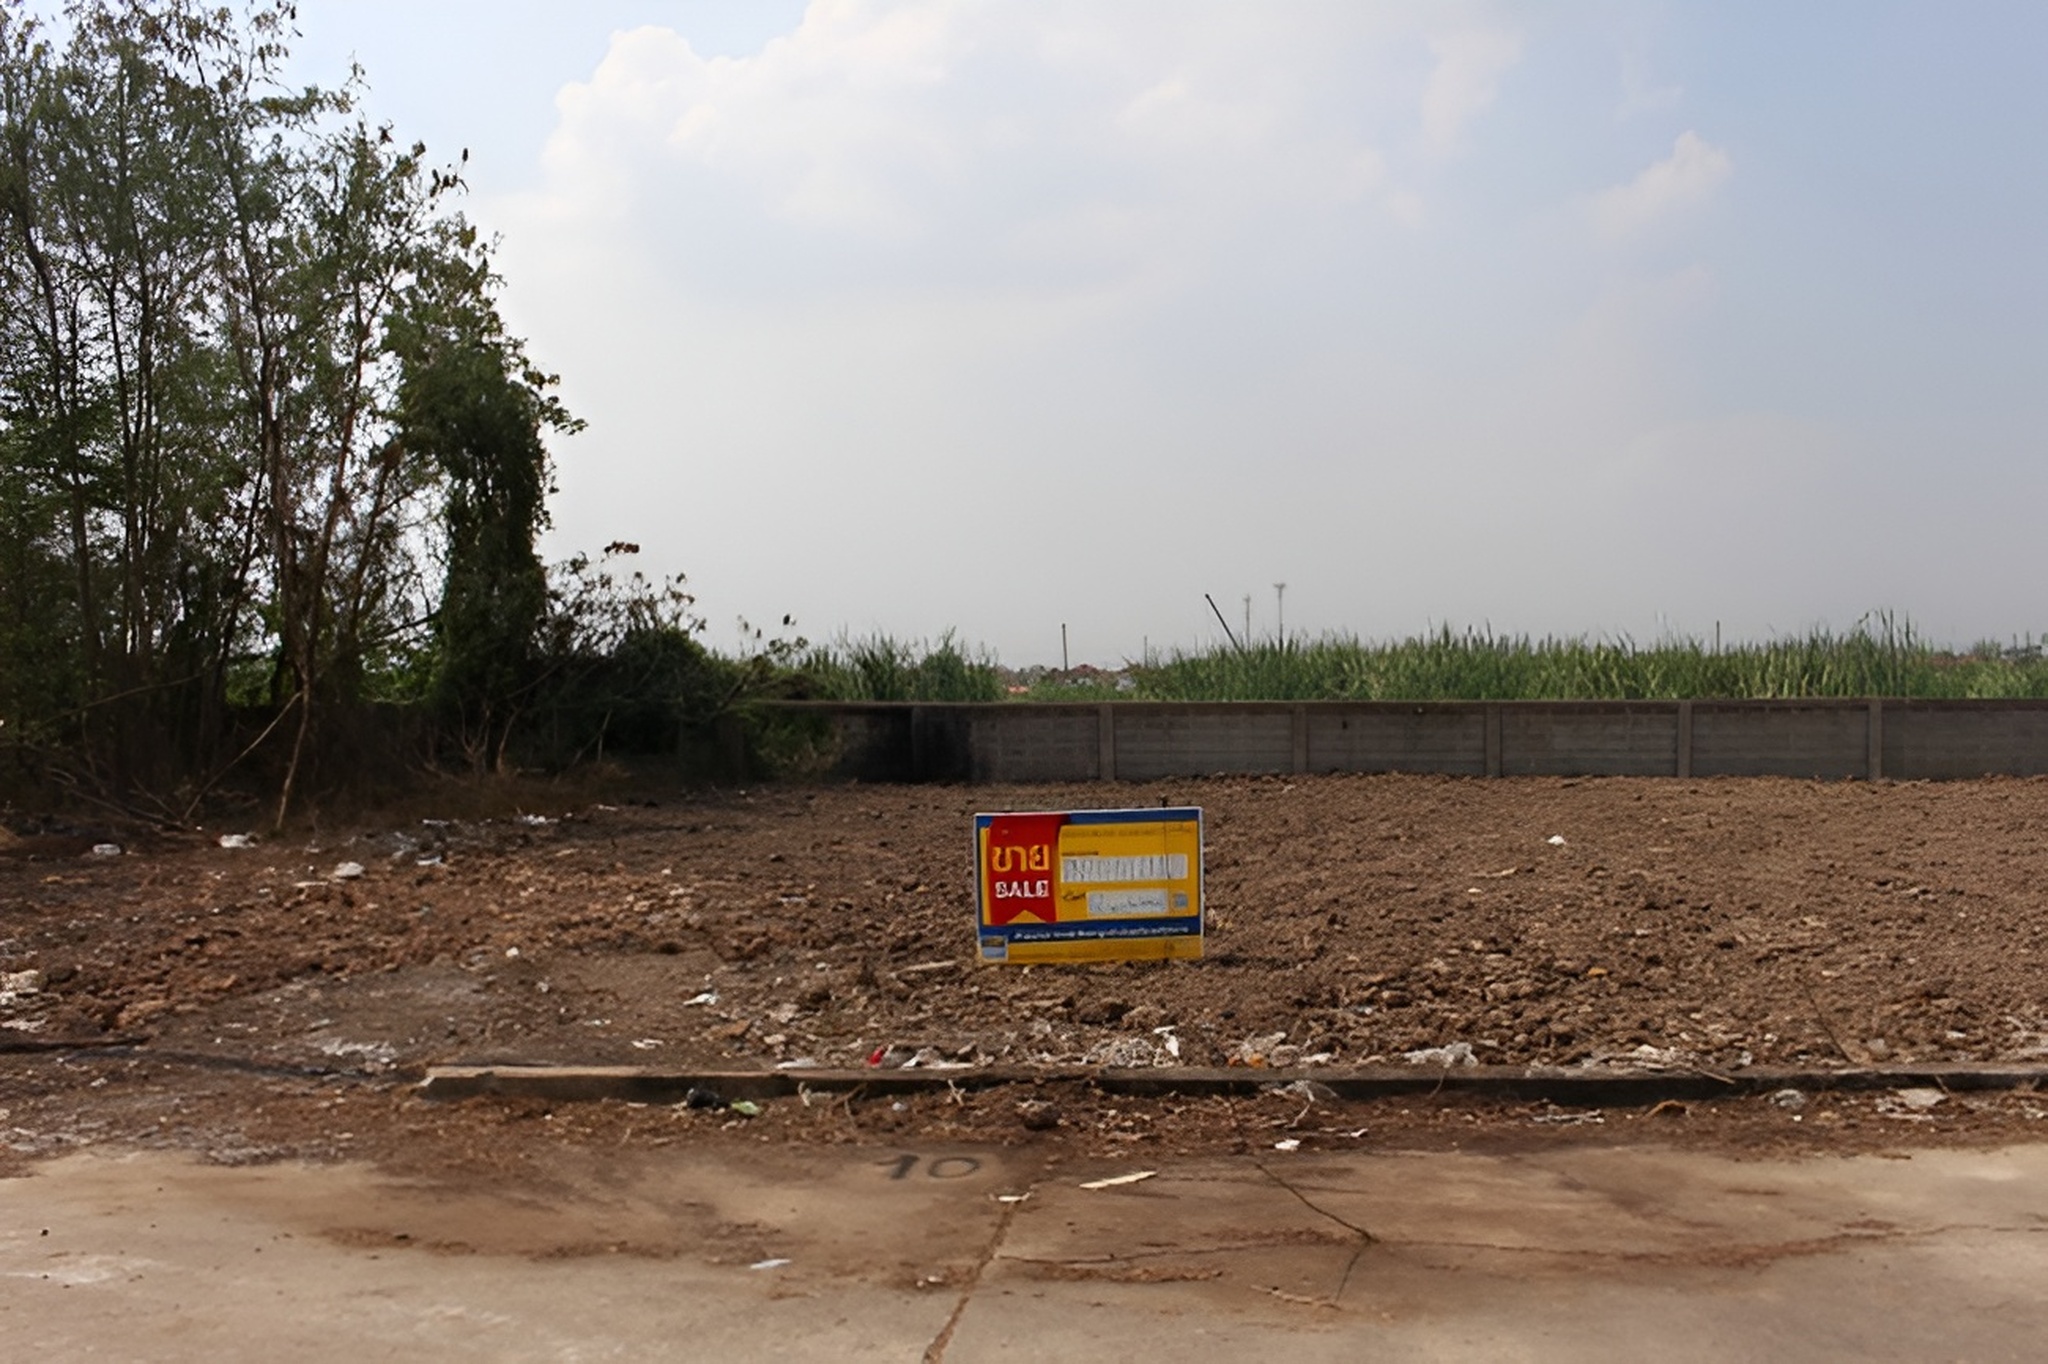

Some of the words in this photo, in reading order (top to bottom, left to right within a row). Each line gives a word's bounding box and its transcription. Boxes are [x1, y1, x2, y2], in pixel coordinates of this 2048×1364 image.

[992, 844, 1050, 872] ขาย
[995, 880, 1049, 898] SALE
[874, 1154, 980, 1180] 10
